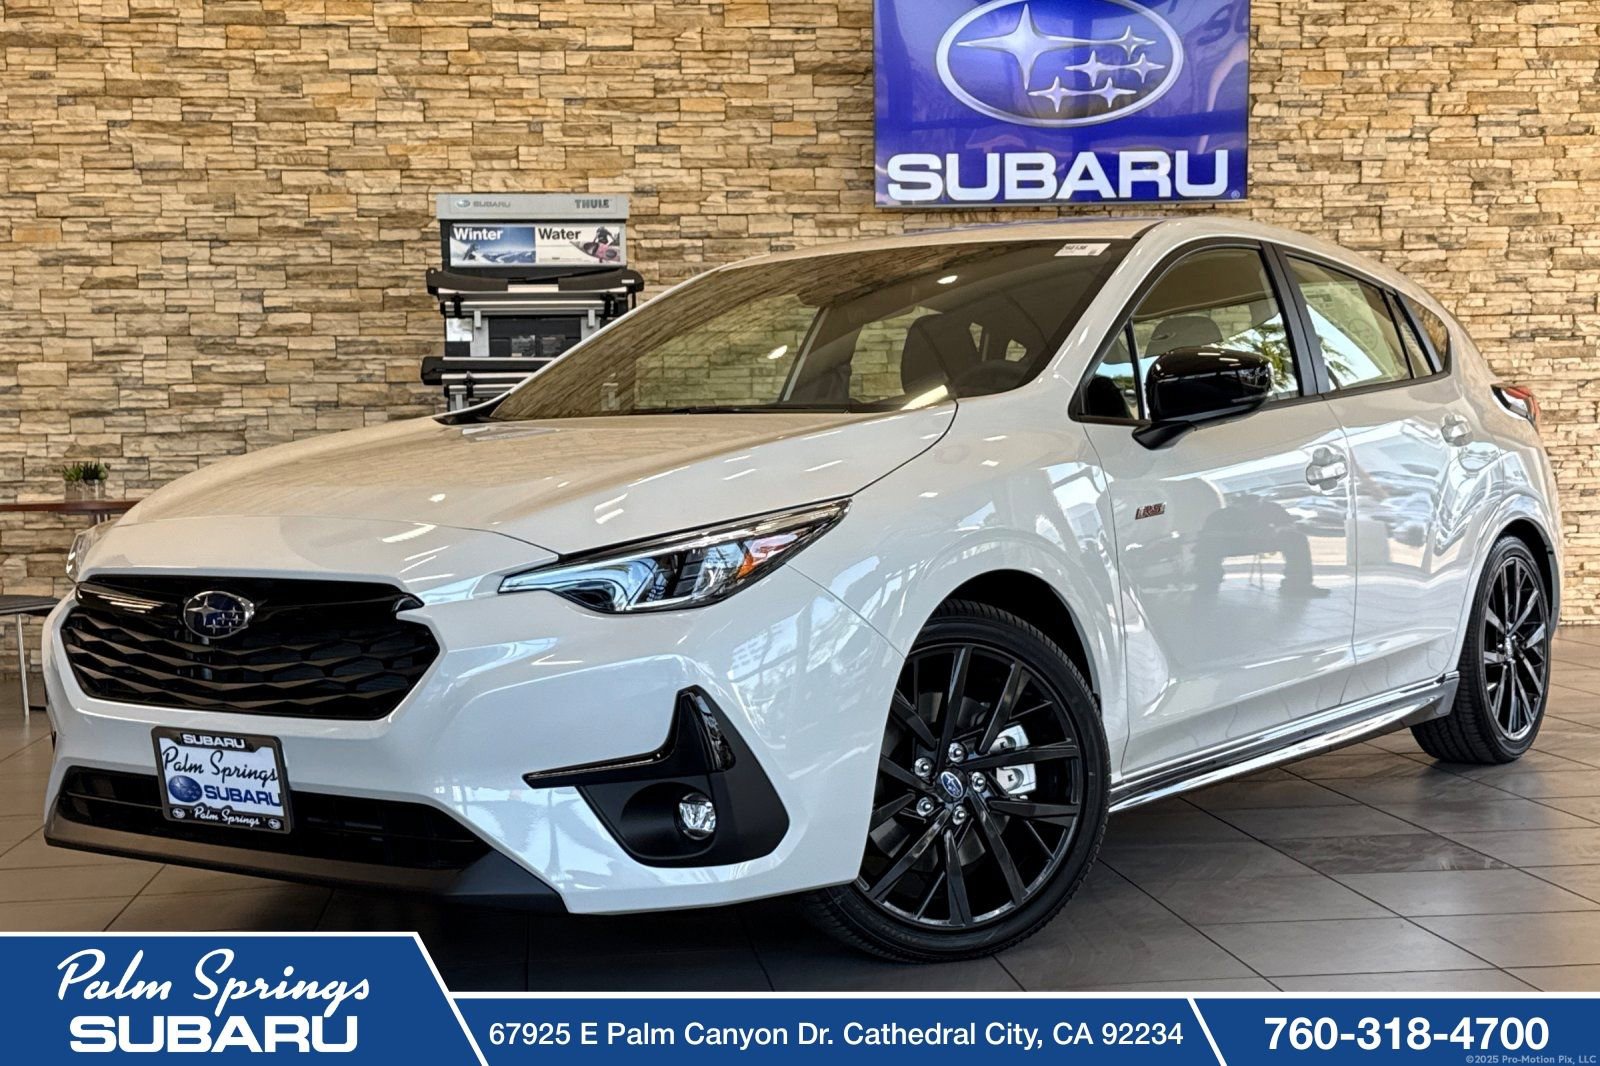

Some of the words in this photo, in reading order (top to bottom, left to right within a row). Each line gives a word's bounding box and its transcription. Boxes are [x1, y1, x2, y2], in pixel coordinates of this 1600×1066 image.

[887, 150, 1229, 201] SUBARU
[575, 199, 610, 209] THULE
[453, 228, 503, 241] Winter
[538, 228, 582, 240] Water
[182, 733, 246, 749] SUBARU
[162, 746, 204, 774] Palm
[210, 749, 279, 788] Springs
[203, 784, 283, 807] SUBARU
[193, 805, 219, 821] Palm
[221, 808, 260, 828] Springs
